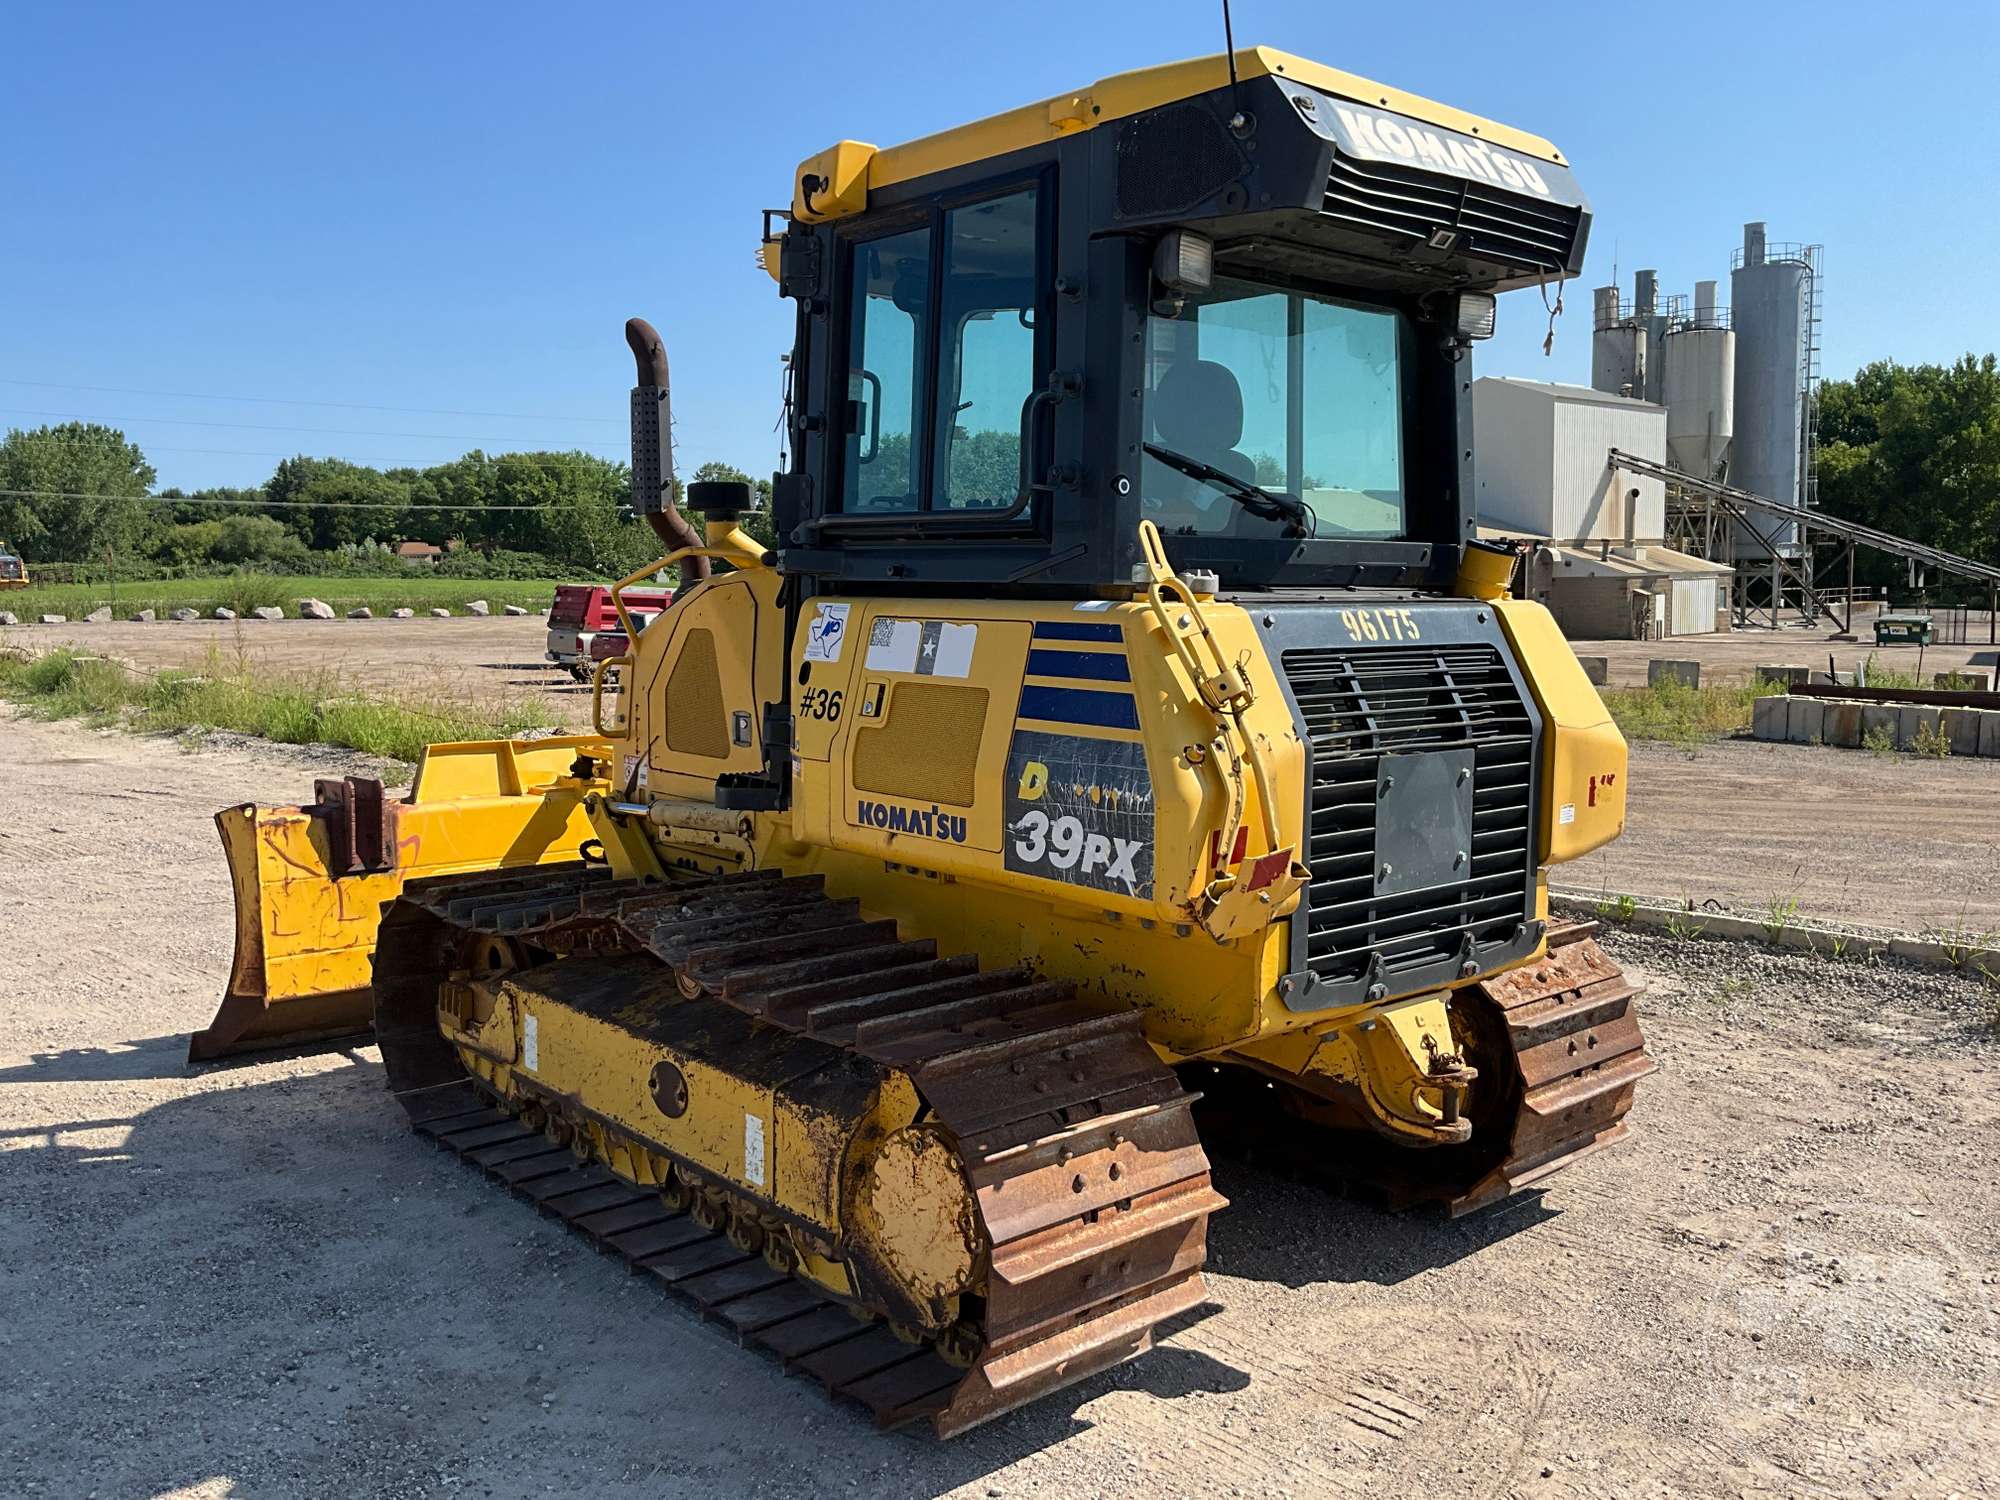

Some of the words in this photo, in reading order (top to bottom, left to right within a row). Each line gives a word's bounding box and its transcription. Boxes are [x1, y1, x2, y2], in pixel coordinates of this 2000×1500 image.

[1336, 107, 1549, 195] KOMATSU
[1342, 609, 1420, 641] 96175
[800, 686, 843, 722] #36
[1018, 760, 1049, 801] D
[858, 799, 967, 843] KOMATSU
[1012, 810, 1144, 882] 39PX
